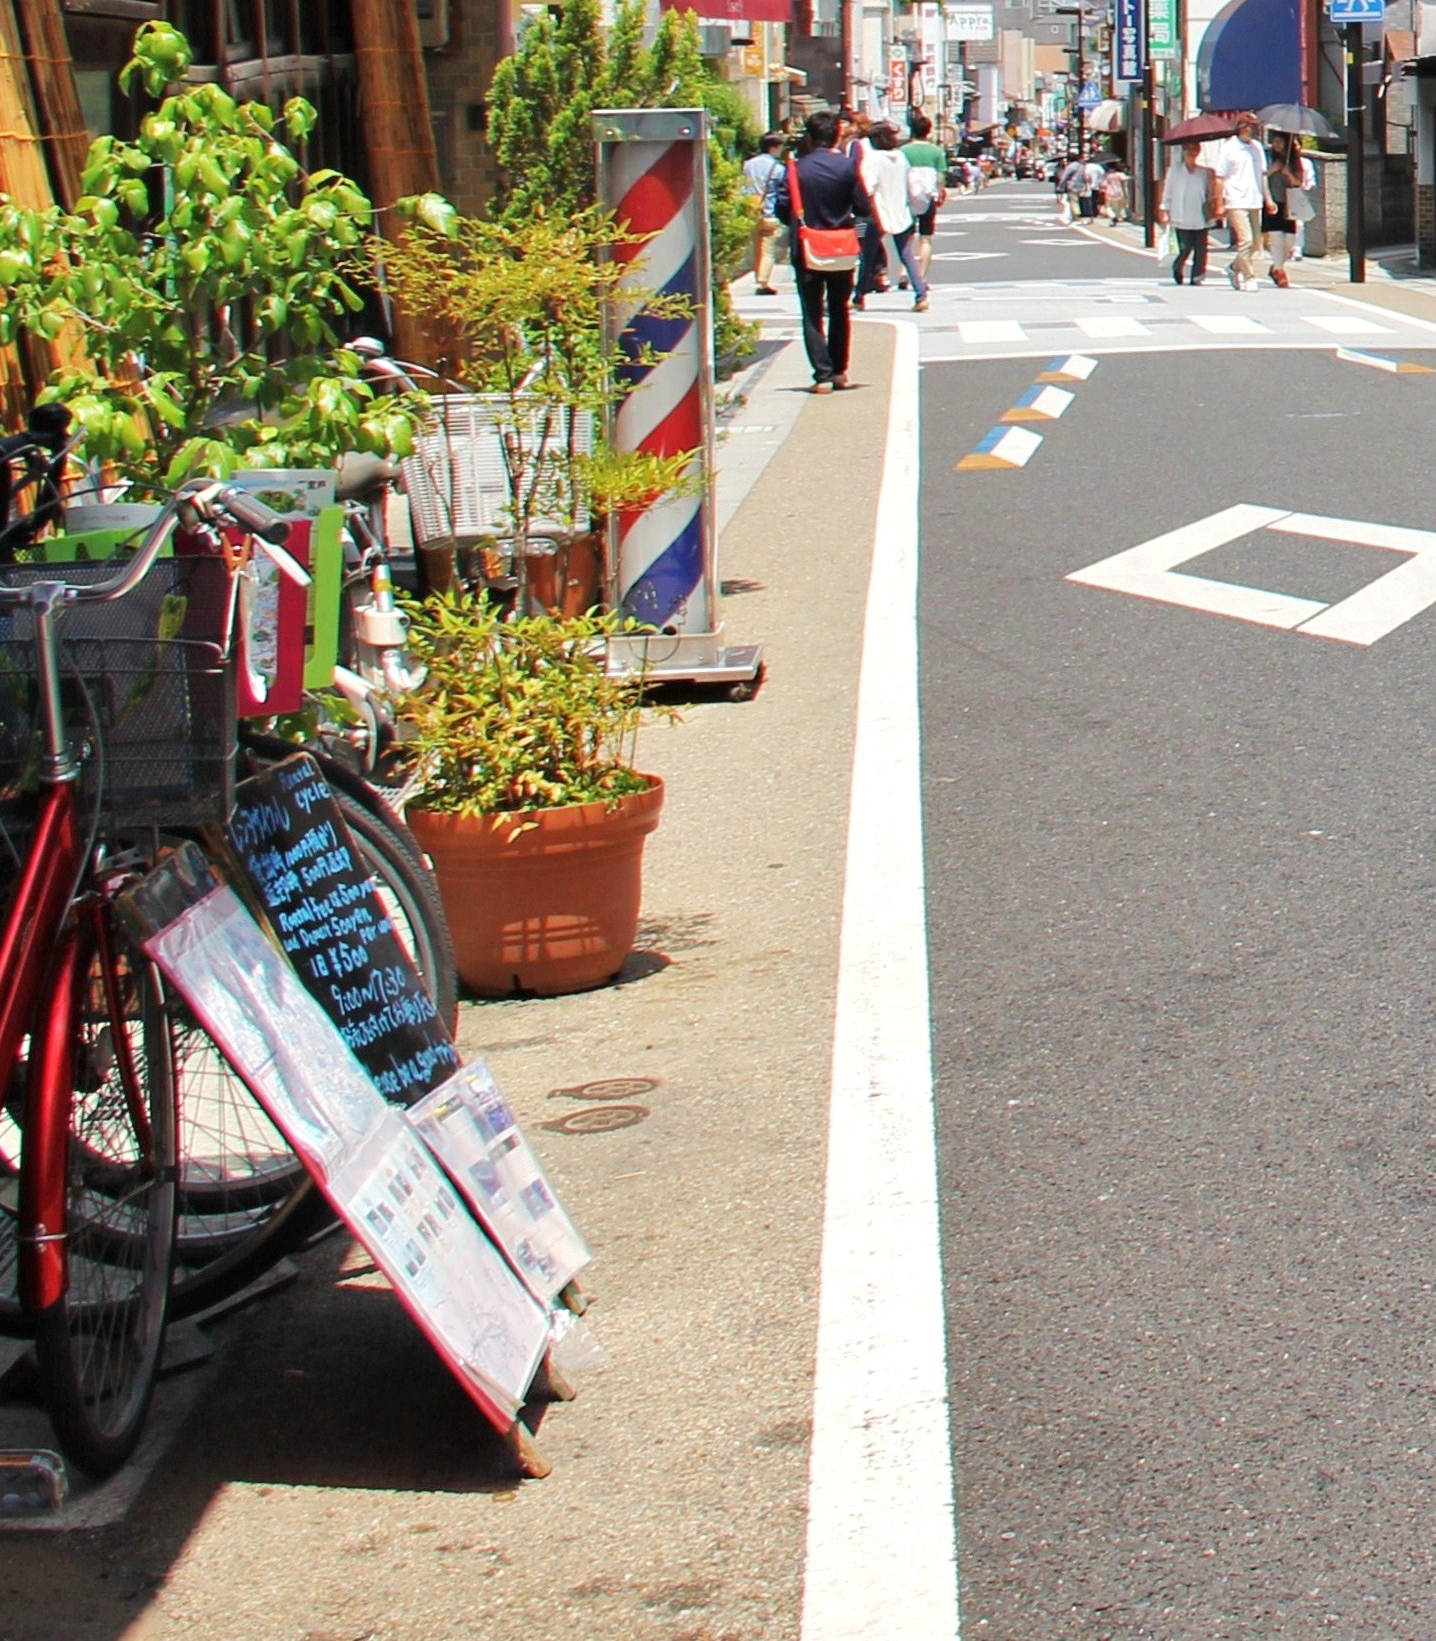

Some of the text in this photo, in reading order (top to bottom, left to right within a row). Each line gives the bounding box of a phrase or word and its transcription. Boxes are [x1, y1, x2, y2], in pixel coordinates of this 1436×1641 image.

[891, 61, 906, 102] くすり
[295, 781, 331, 814] cycle
